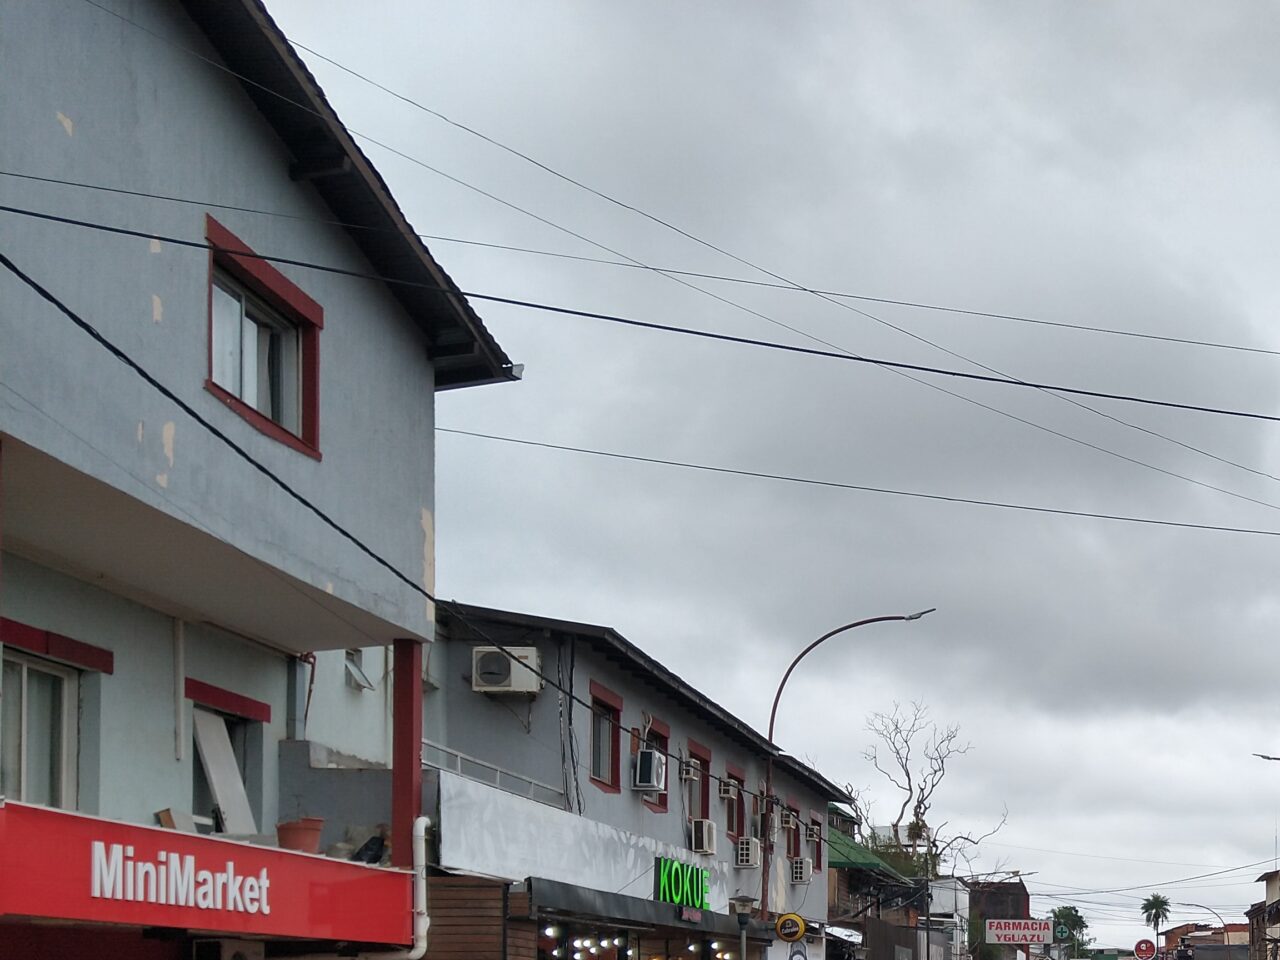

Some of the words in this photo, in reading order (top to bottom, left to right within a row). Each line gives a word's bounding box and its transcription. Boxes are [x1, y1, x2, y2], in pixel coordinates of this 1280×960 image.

[91, 841, 271, 915] MiniMarket
[660, 856, 710, 910] KOKUE
[988, 921, 1050, 931] FARMACIA
[995, 934, 1045, 943] YGUAZU
